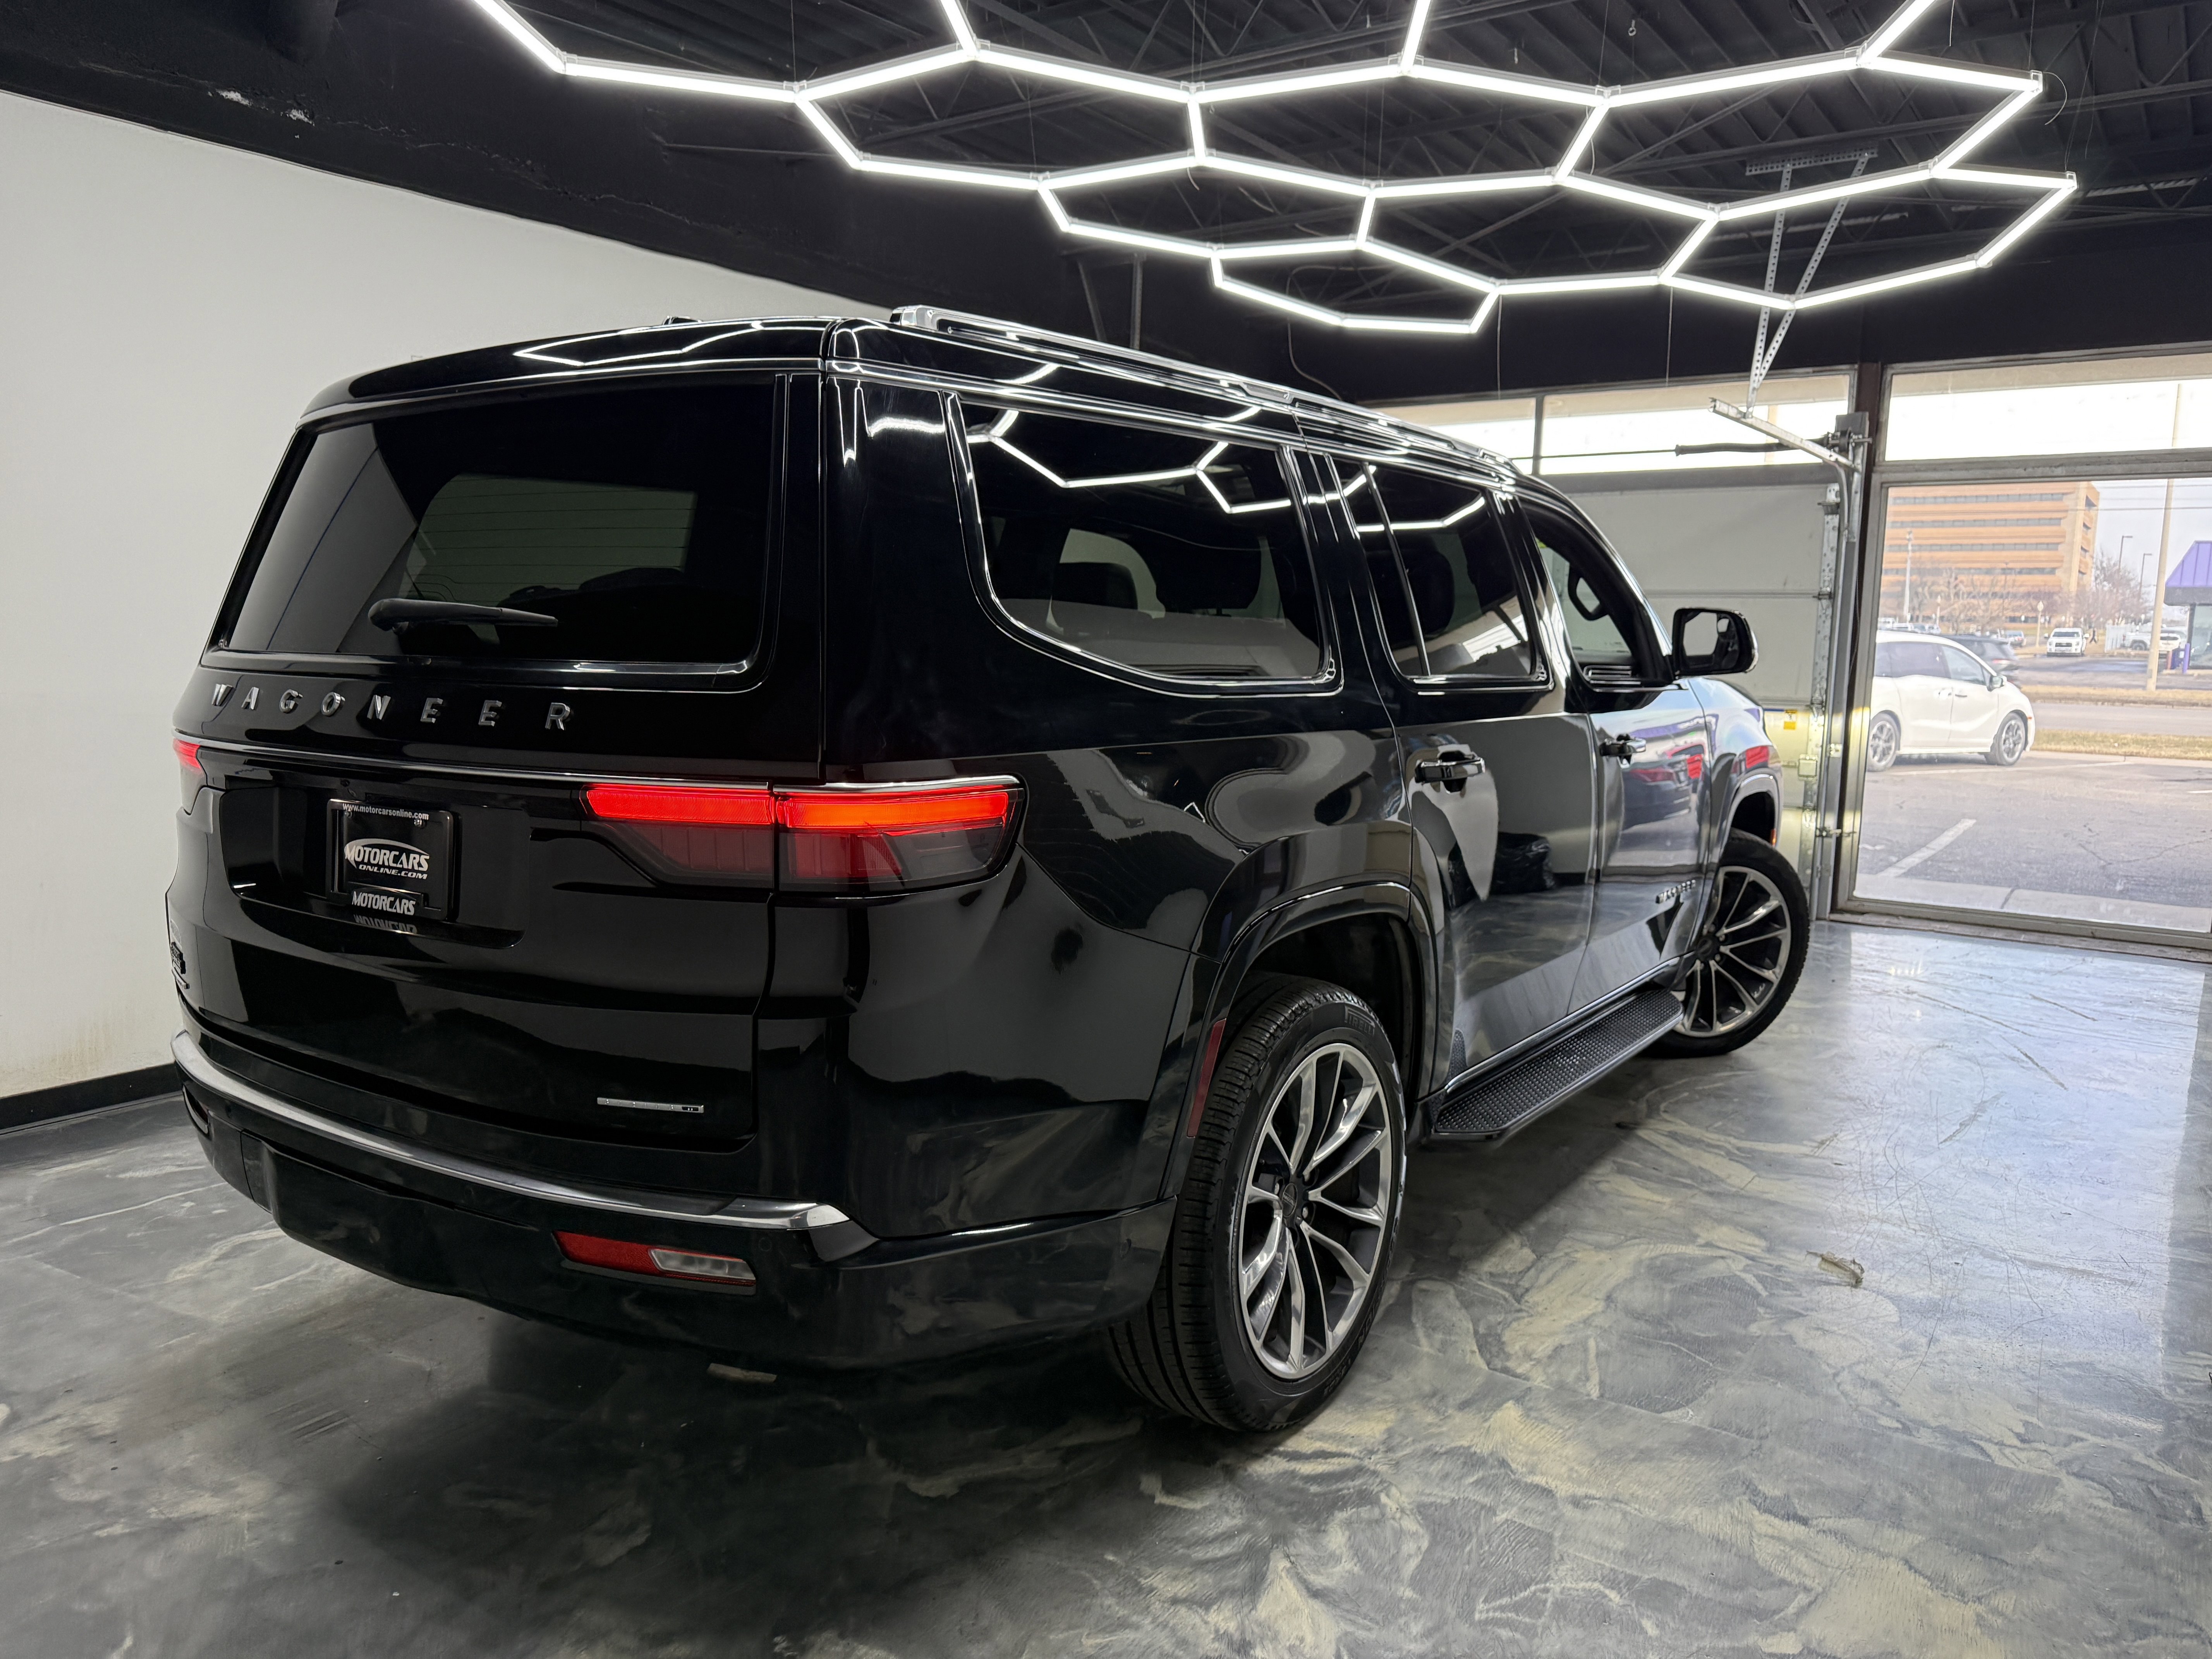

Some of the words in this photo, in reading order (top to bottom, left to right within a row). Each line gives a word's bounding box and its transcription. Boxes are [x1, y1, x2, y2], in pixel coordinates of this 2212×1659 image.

[211, 684, 571, 730] WAGONEER
[343, 803, 429, 820] www.motorcarsonline.com
[345, 845, 430, 871] MOTORCARS
[359, 864, 428, 879] ONLINE.COM
[352, 891, 416, 915] MOTORCARS
[1344, 1005, 1376, 1037] PIRELLI
